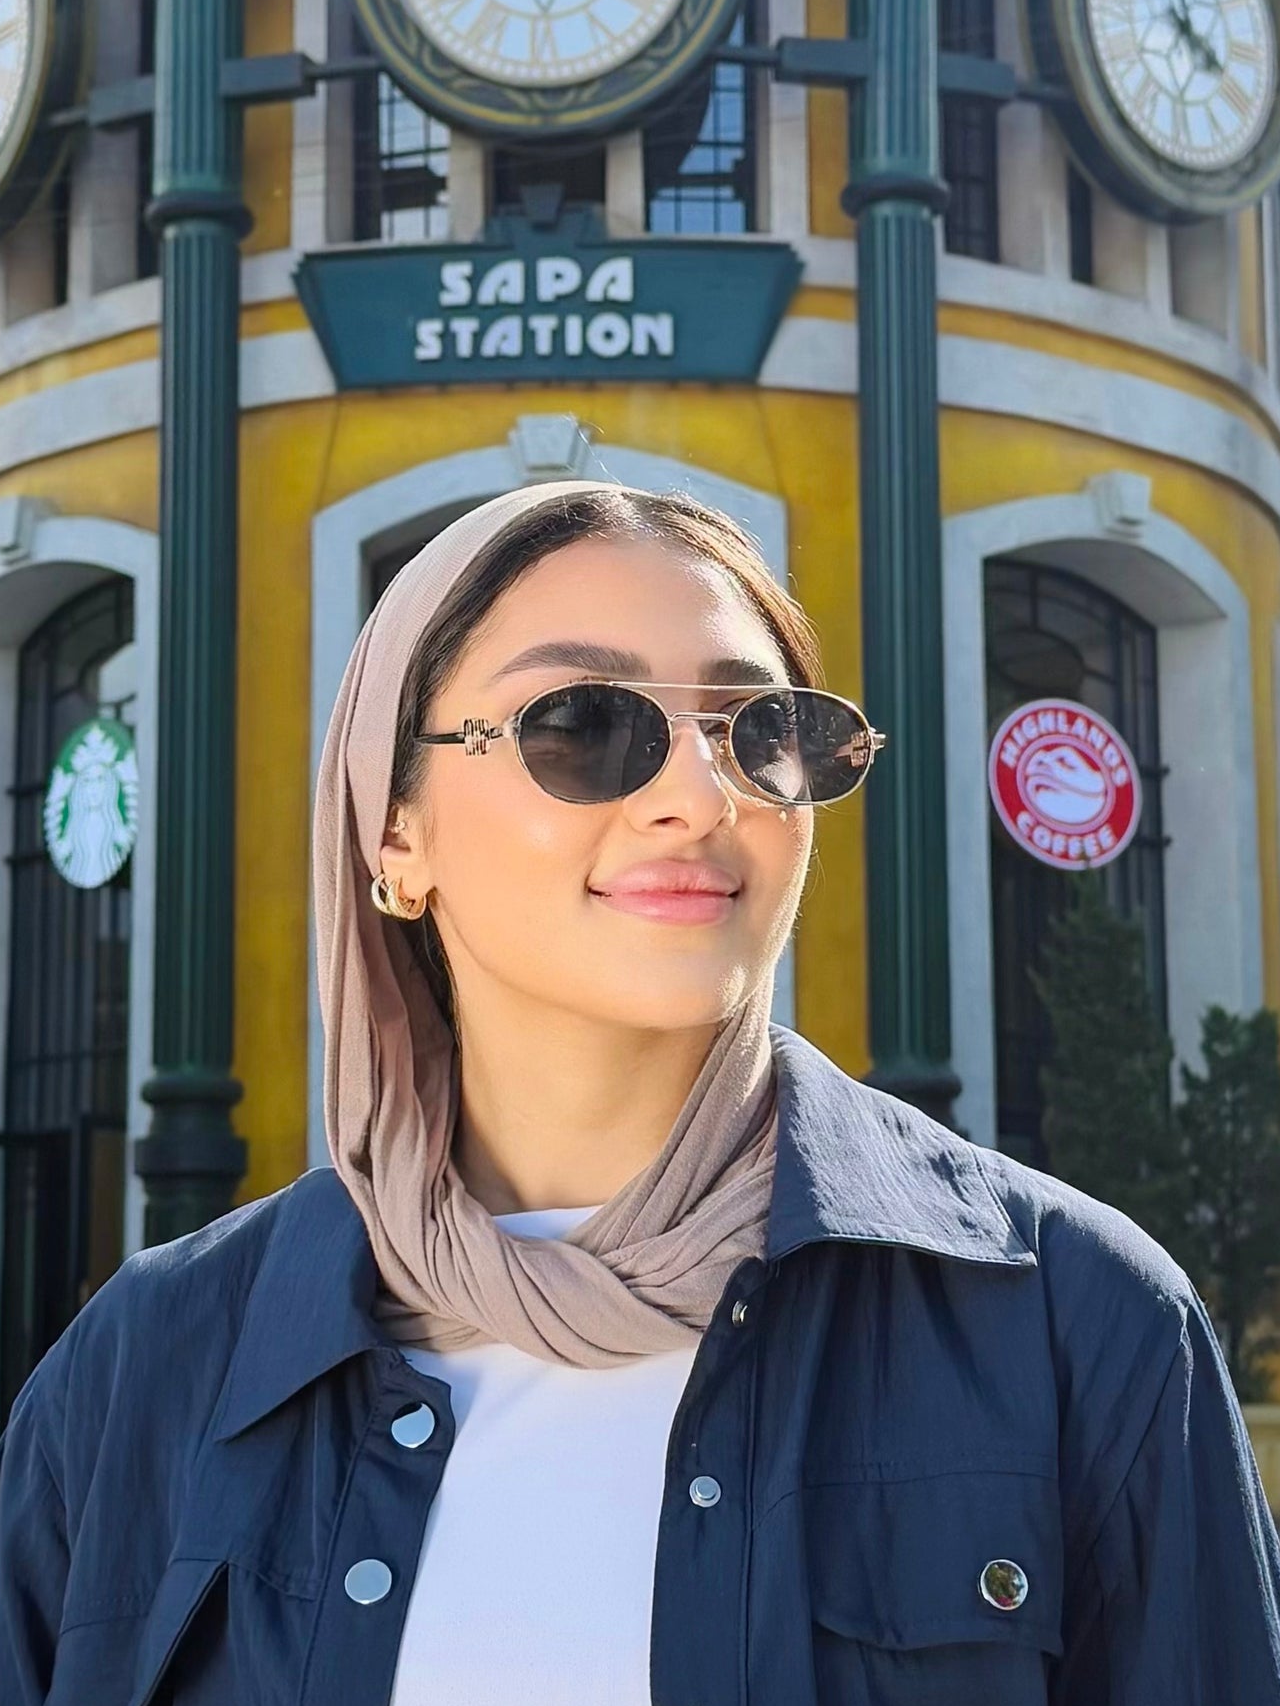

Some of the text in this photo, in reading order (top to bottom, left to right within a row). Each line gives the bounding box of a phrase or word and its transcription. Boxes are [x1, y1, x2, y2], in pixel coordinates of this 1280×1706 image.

[438, 256, 634, 307] SAPA
[415, 312, 674, 360] STATION
[1000, 709, 1128, 788] HIGHLANDS
[1016, 811, 1116, 860] COFFEE
